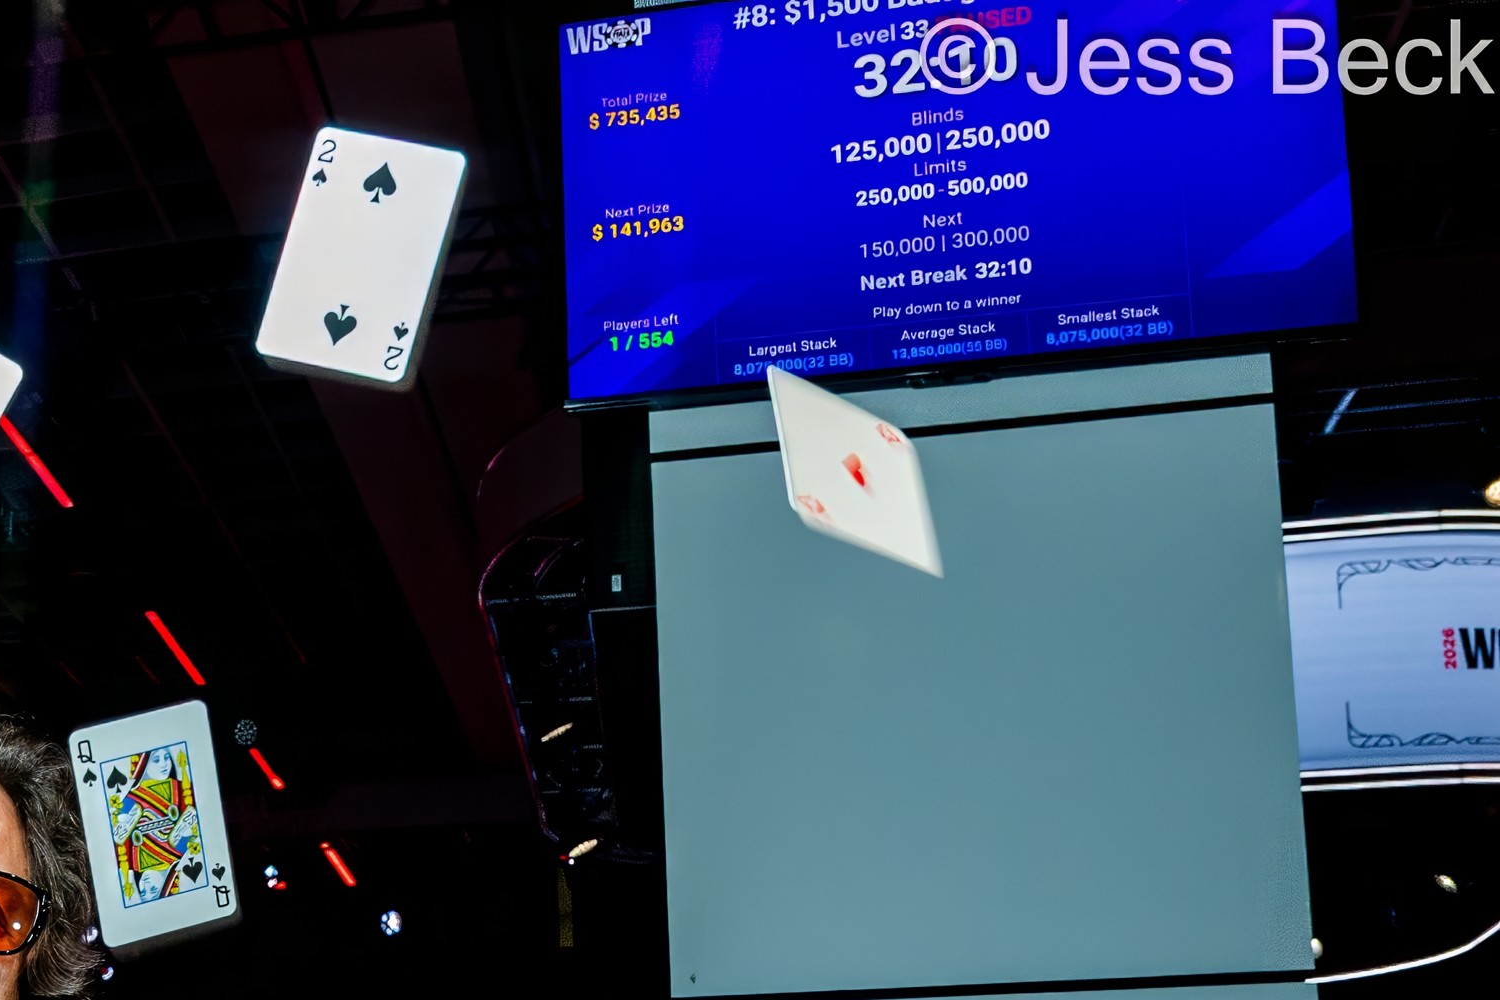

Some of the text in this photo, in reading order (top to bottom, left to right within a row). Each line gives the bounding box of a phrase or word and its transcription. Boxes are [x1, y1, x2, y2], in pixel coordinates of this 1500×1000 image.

[733, 6, 776, 30] #8:
[836, 23, 896, 49] Level
[900, 19, 930, 41] 33
[854, 36, 1018, 98] 32:10
[601, 91, 668, 108] Total Prize
[605, 103, 681, 127] 735,435
[911, 107, 964, 126] Blinds
[317, 139, 337, 163] 2
[830, 132, 932, 164] 125,000
[945, 118, 1051, 151] 250,000
[913, 158, 968, 177] Limits
[855, 182, 935, 207] 250,000
[947, 171, 1029, 196] 500,000
[605, 203, 670, 219] Next Prize
[922, 211, 964, 228] Next
[609, 215, 685, 238] 141,963
[859, 235, 936, 258] 150,000
[951, 225, 1031, 249] 300,000
[860, 257, 1033, 292] Next Break 32:10
[873, 306, 902, 320] Play
[905, 302, 942, 316] down
[946, 300, 960, 312] to
[976, 294, 1022, 308] winner
[1057, 304, 1160, 325] Smallest Stack
[603, 313, 679, 332] Players Left
[900, 321, 996, 341] Average Stack
[800, 337, 837, 352] Stack
[383, 345, 404, 370] 2
[1458, 627, 1500, 670] W
[77, 739, 96, 764] Q
[212, 885, 231, 908] Q
